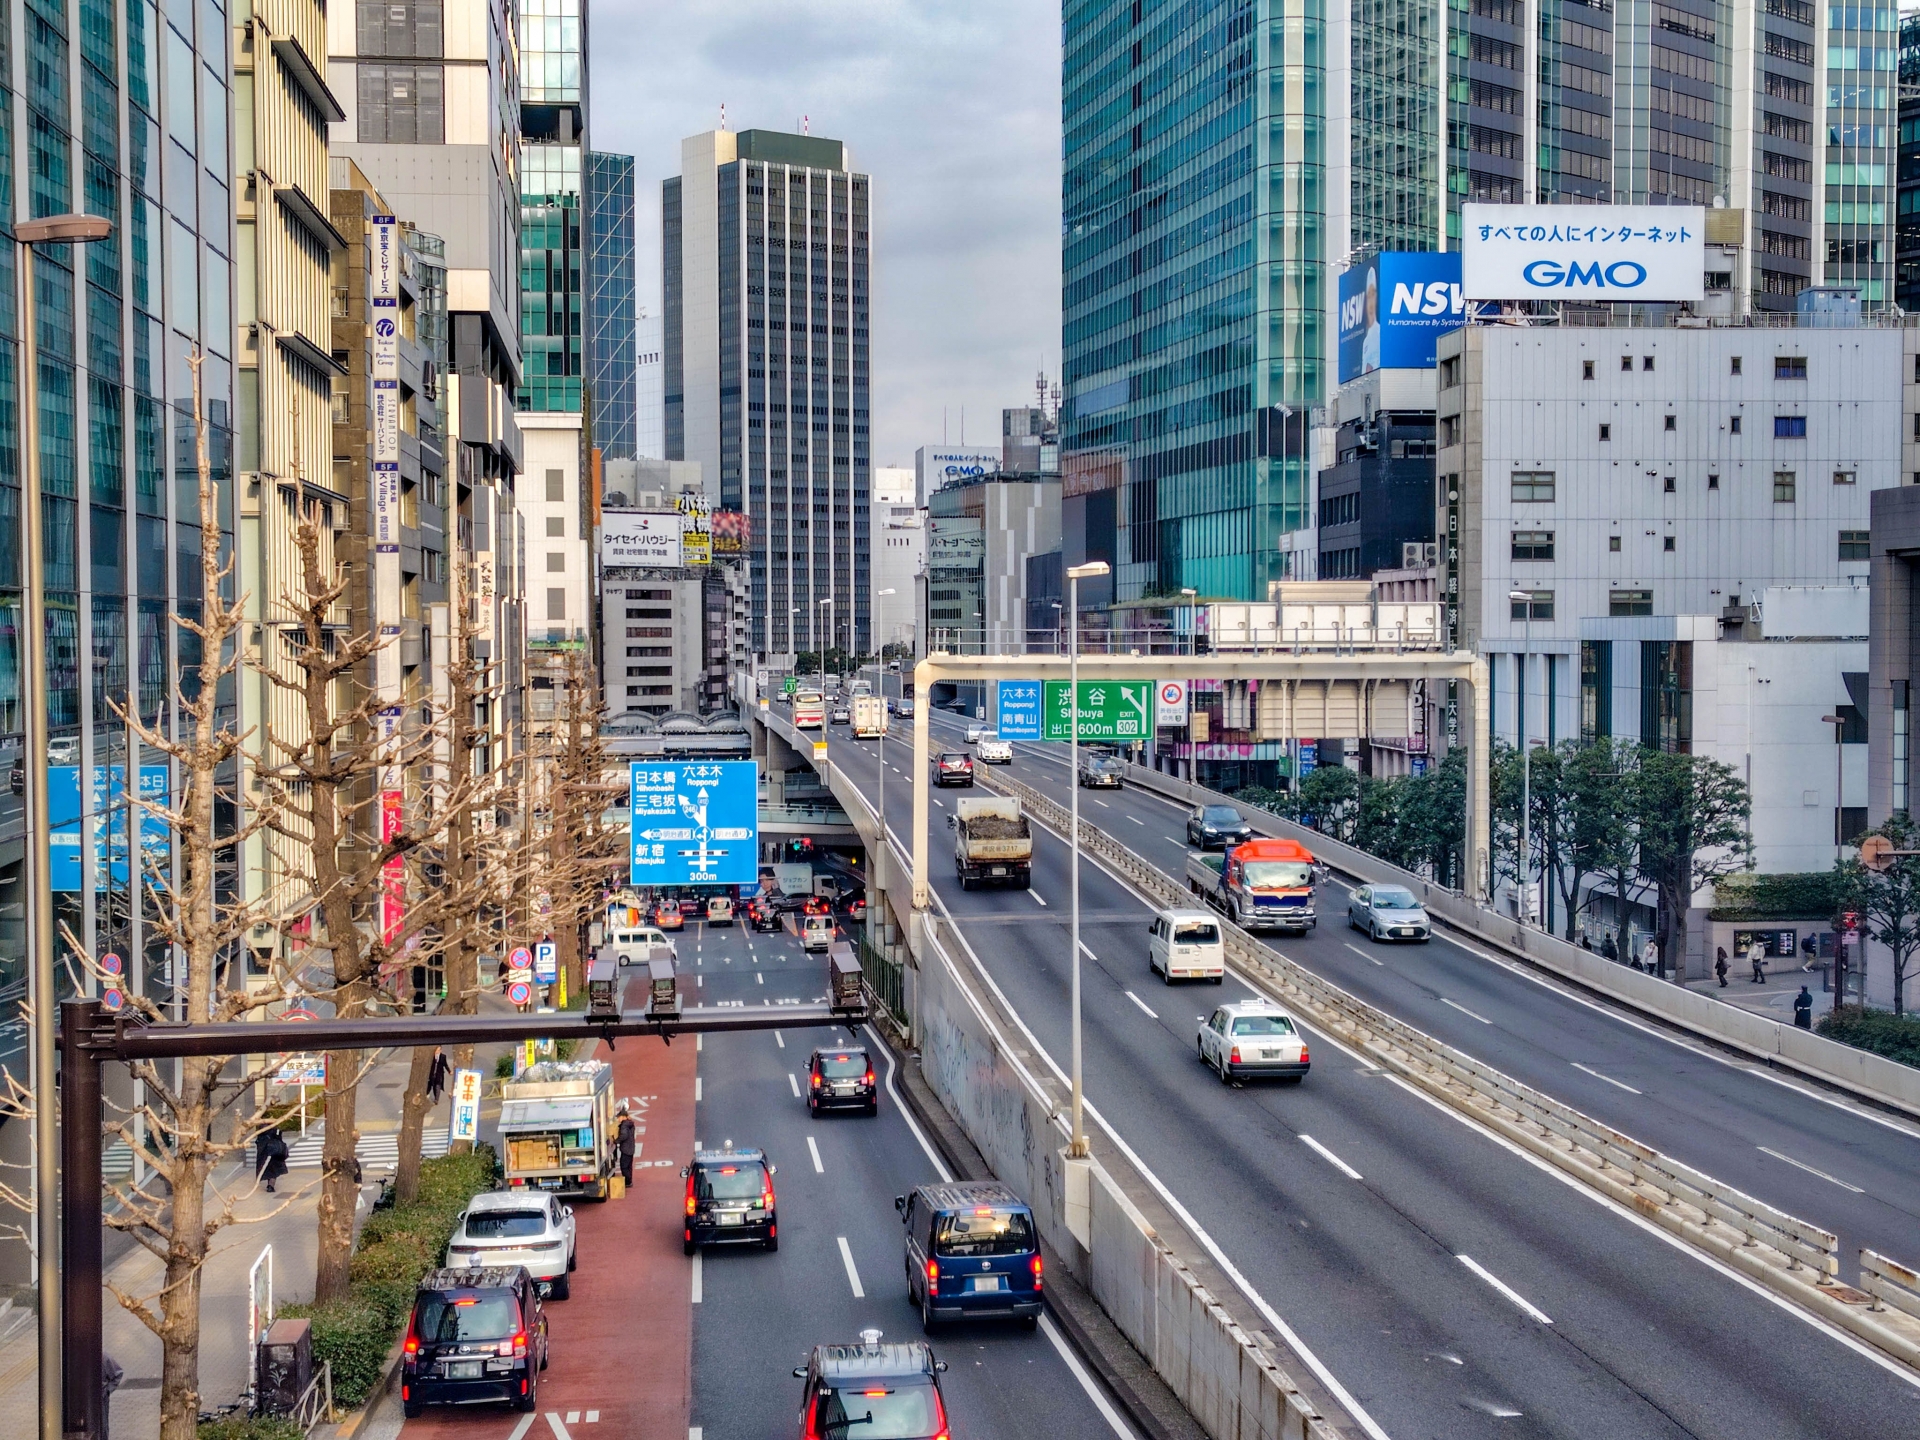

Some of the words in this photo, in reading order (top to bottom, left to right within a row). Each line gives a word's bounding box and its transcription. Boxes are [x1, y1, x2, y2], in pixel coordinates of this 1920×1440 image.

[1478, 224, 1693, 244] すべての人にインターネット
[1523, 260, 1647, 289] GMO
[1341, 292, 1366, 333] NSW
[1388, 319, 1431, 327] Humanware
[1432, 319, 1440, 328] By
[381, 463, 393, 471] 5F
[945, 465, 984, 477] GMO
[1002, 688, 1037, 699] 六本木
[1004, 701, 1035, 709] Roppongi
[1002, 713, 1037, 725] 南青山
[1060, 707, 1104, 720] Shbuya
[1078, 723, 1113, 735] 600m
[1119, 721, 1136, 733] 302
[1409, 741, 1423, 749] 3F
[635, 771, 676, 784] 日本橋
[682, 765, 723, 778] 六本木
[687, 778, 719, 787] Roppongi
[635, 794, 676, 807] 三宅坂
[635, 807, 676, 816] Miyakezaka
[635, 844, 665, 856] 新宿
[1002, 845, 1018, 853] 3717
[635, 857, 666, 865] Shinjuku
[690, 872, 717, 881] 300m
[540, 946, 552, 961] P
